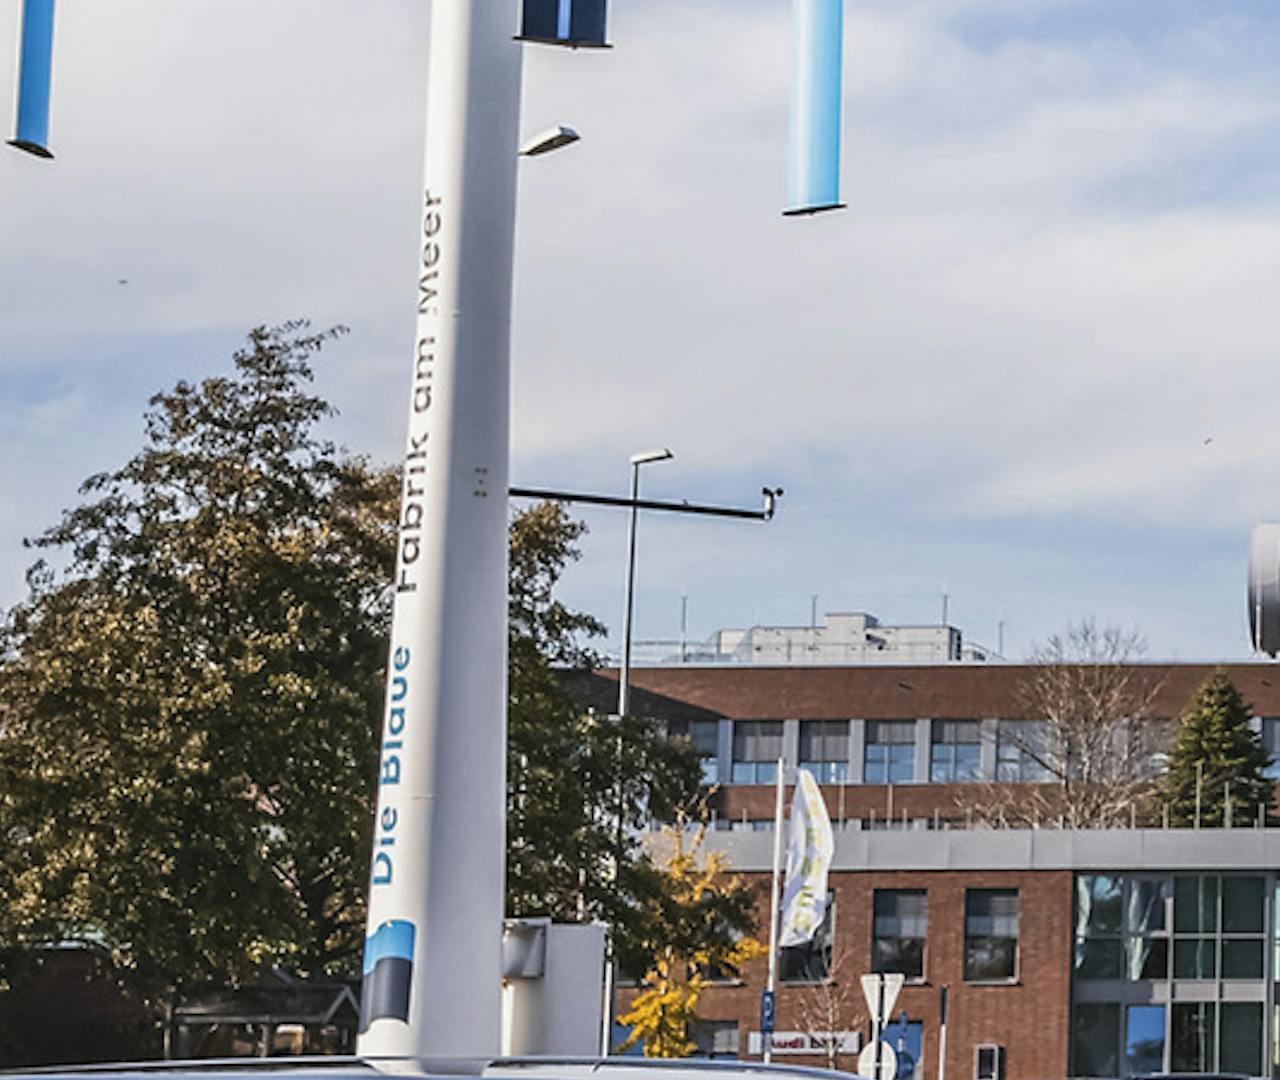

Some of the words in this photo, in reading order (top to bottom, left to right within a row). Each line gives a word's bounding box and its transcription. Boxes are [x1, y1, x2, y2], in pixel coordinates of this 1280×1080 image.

[419, 189, 442, 315] Meer
[414, 336, 435, 414] am
[397, 432, 429, 593] Fabrik
[380, 645, 410, 785] Blaue
[372, 806, 398, 885] Die
